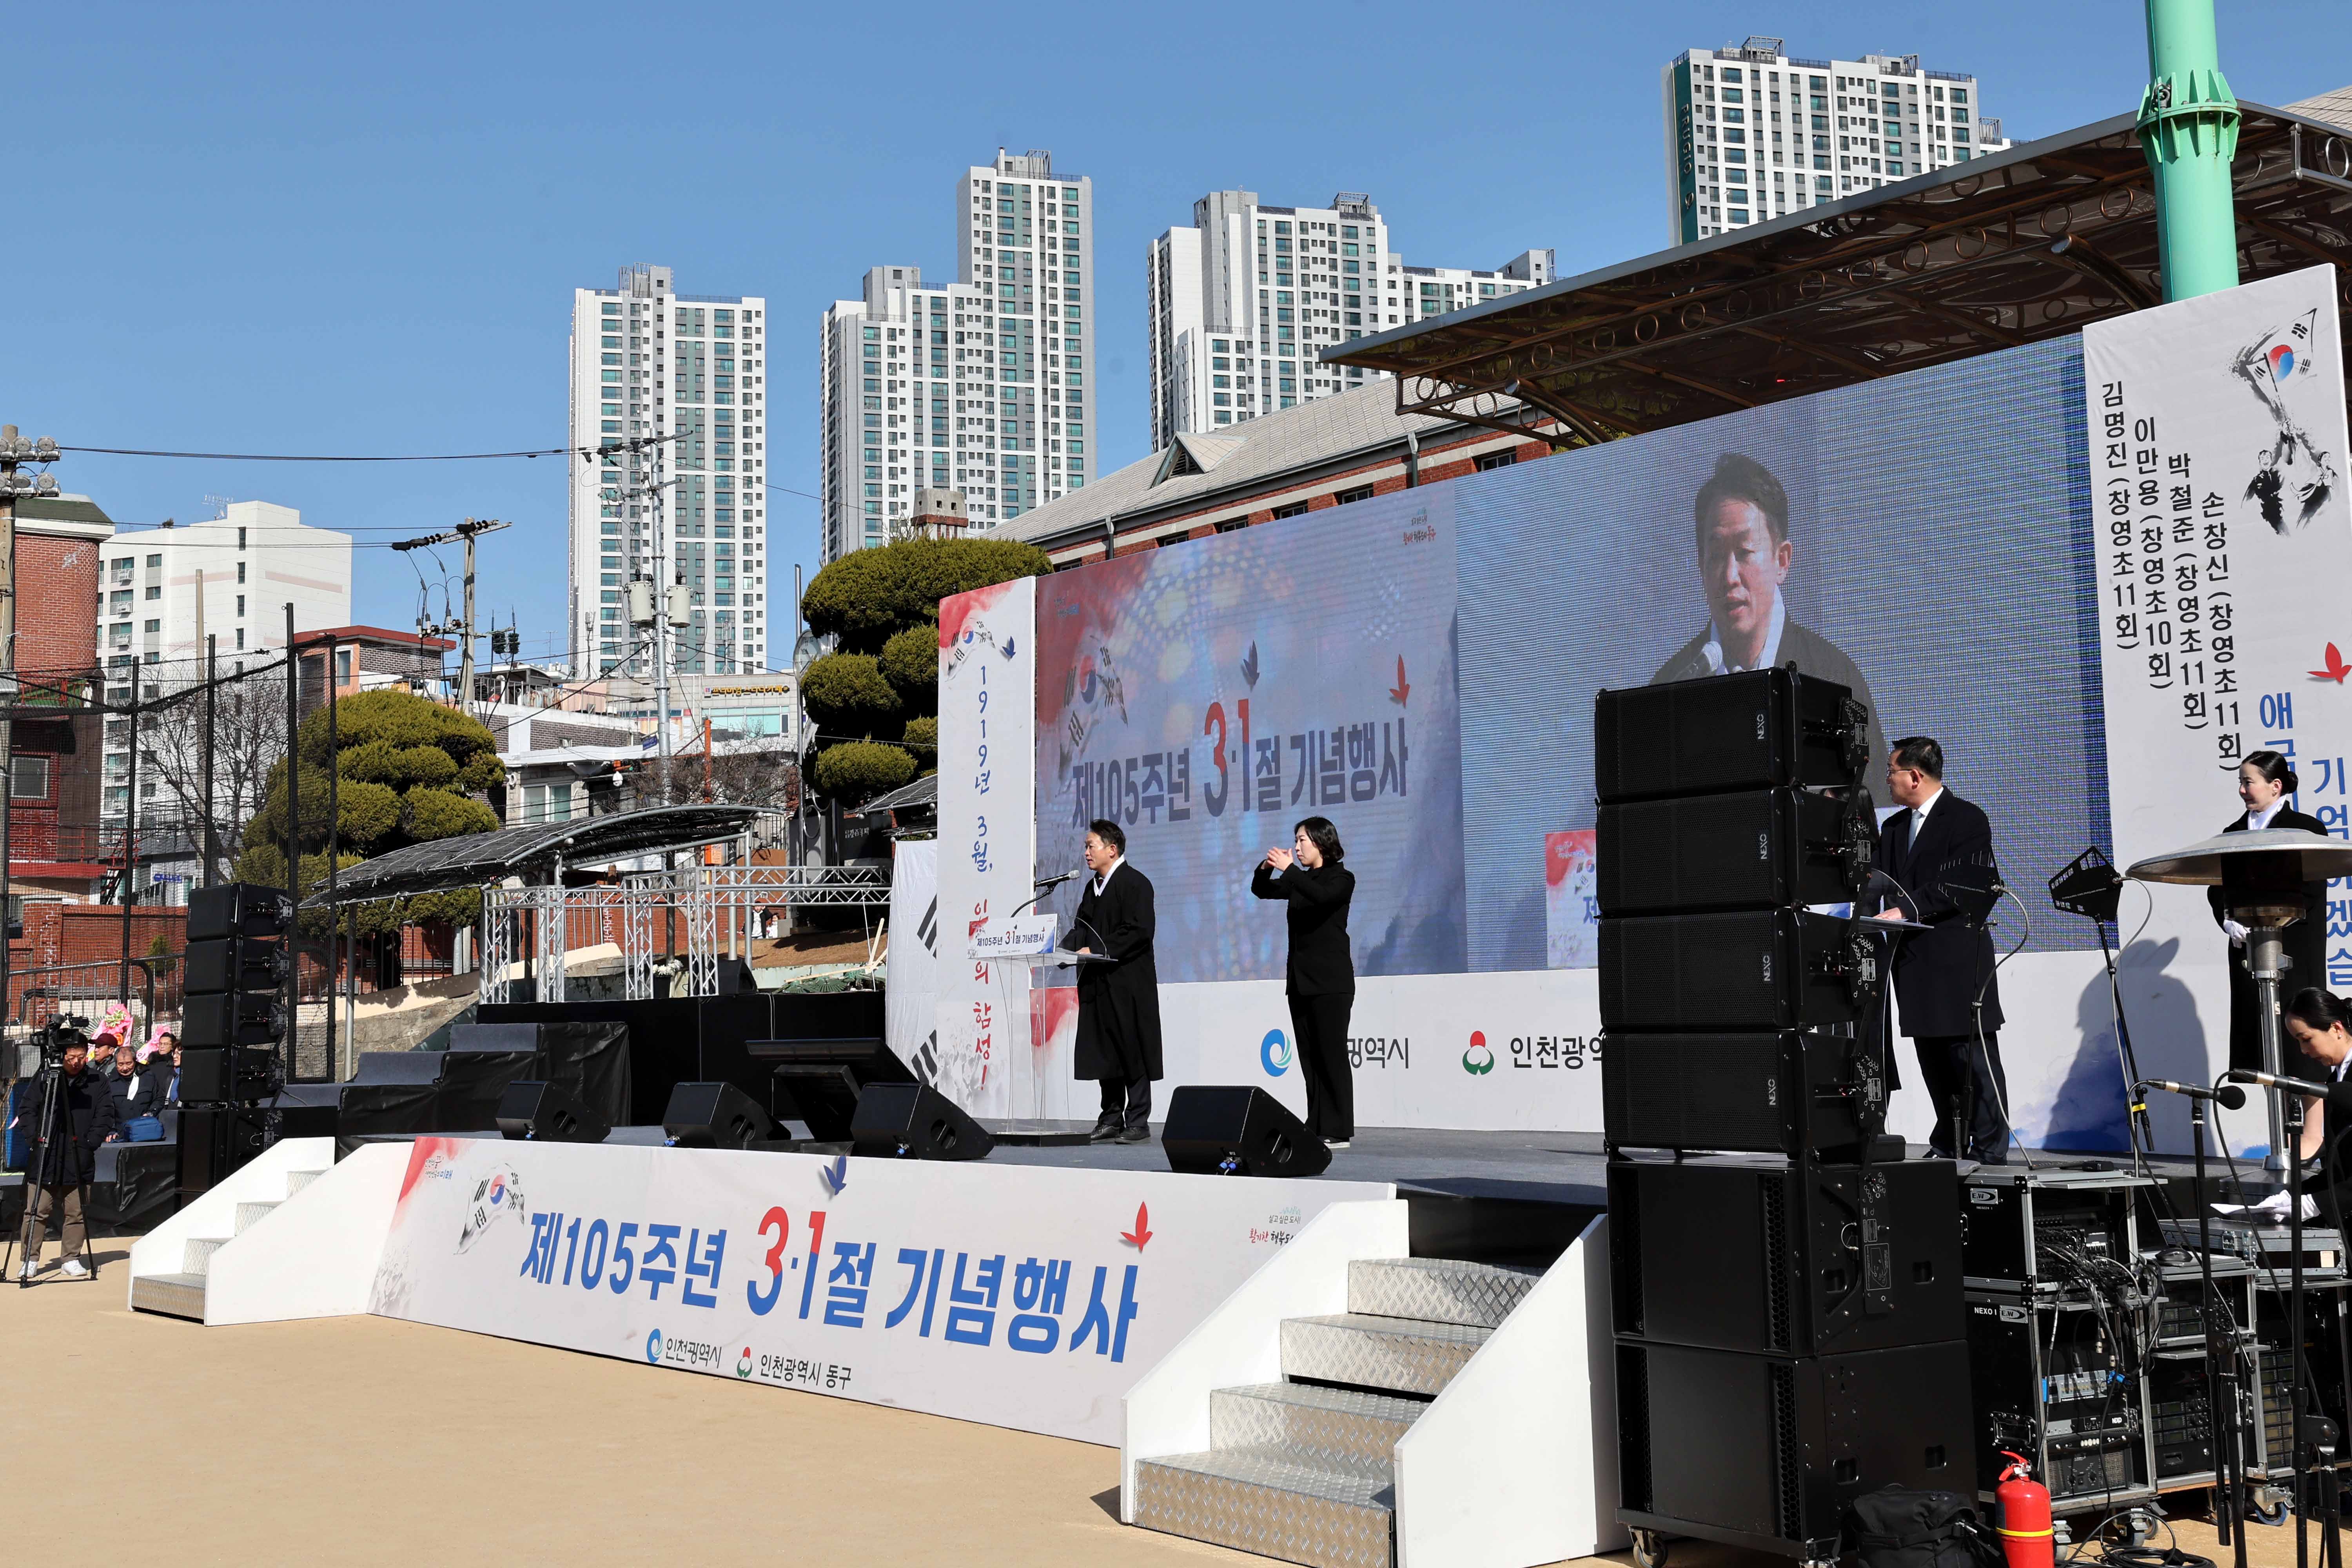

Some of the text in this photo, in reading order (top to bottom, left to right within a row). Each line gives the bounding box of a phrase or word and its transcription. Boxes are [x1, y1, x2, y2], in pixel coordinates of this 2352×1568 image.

[1681, 103, 1691, 174] PRUGIO
[975, 665, 991, 795] 1919년
[1073, 748, 1190, 831] 제105주년
[1290, 718, 1408, 807] 기념행사
[971, 816, 993, 872] 3월,
[977, 936, 1003, 946] 제105주년
[1022, 933, 1044, 943] 기념행사
[973, 1001, 992, 1091] 함성!
[1347, 1038, 1408, 1069] 광역시
[439, 1170, 453, 1180] 미래
[1249, 1228, 1269, 1243] 활기찬
[1269, 1215, 1301, 1224] 살고 싶은 도시!
[520, 1212, 727, 1308] 제105주년
[885, 1248, 1138, 1363] 기념행사
[666, 1338, 722, 1368] 인천광역시
[760, 1354, 851, 1390] 인천광역시 동구
